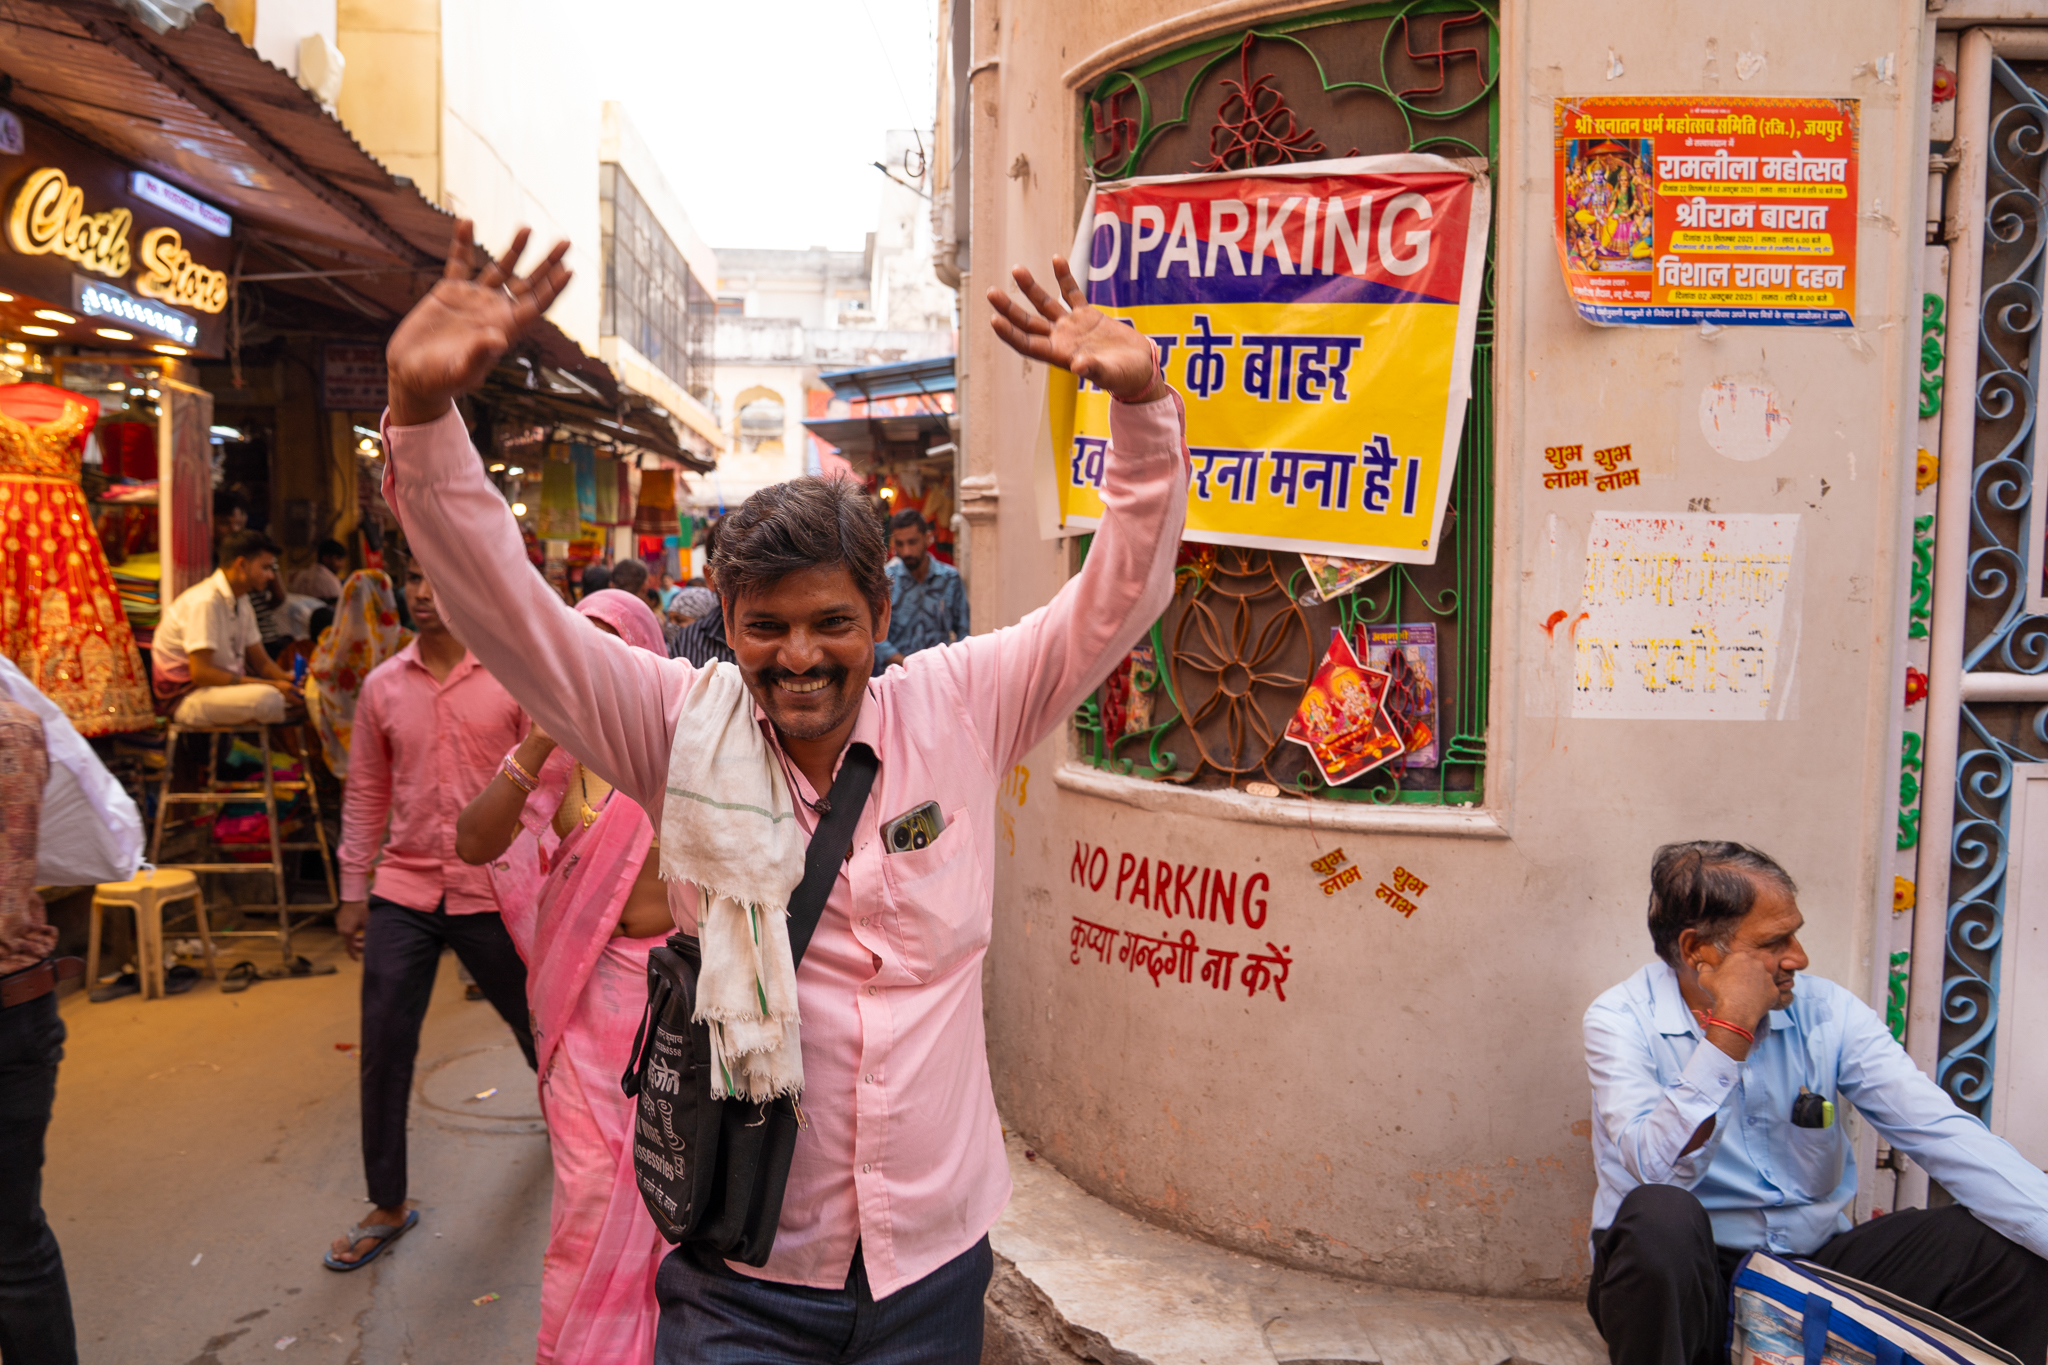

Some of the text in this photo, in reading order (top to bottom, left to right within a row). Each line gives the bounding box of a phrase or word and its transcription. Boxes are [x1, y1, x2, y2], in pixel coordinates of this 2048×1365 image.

[1575, 113, 1592, 134] श्री
[1594, 118, 1641, 134] सनातन
[1643, 112, 1664, 134] धर्म
[1665, 113, 1716, 134] महोत्सव
[1717, 114, 1757, 135] समिति
[1803, 119, 1844, 142] जयपुर
[1657, 149, 1848, 182] रामलीला महोत्सव
[1675, 197, 1829, 230] श्रीराम बारात
[10, 167, 133, 278] Cloth
[136, 227, 228, 314] Store
[1088, 192, 1433, 281] O PARKING
[1656, 255, 1846, 290] विशाल रावण दहन
[1735, 293, 1753, 301] 2025
[1185, 314, 1233, 399] के
[1242, 336, 1363, 402] बाहर
[1544, 444, 1583, 470] शुभ
[1593, 444, 1632, 471] शुभ
[1188, 447, 1265, 503] रना
[1270, 450, 1357, 512] मना
[1543, 469, 1589, 490] लाभ
[1594, 468, 1640, 492] लाभ
[1310, 847, 1348, 876] शुभ
[1071, 840, 1269, 930] NO PARKING
[1319, 864, 1363, 897] लाभ
[1391, 865, 1430, 898] शुभ
[1374, 882, 1419, 919] लाभ
[1201, 948, 1239, 991] ना
[1241, 941, 1293, 1002] करें
